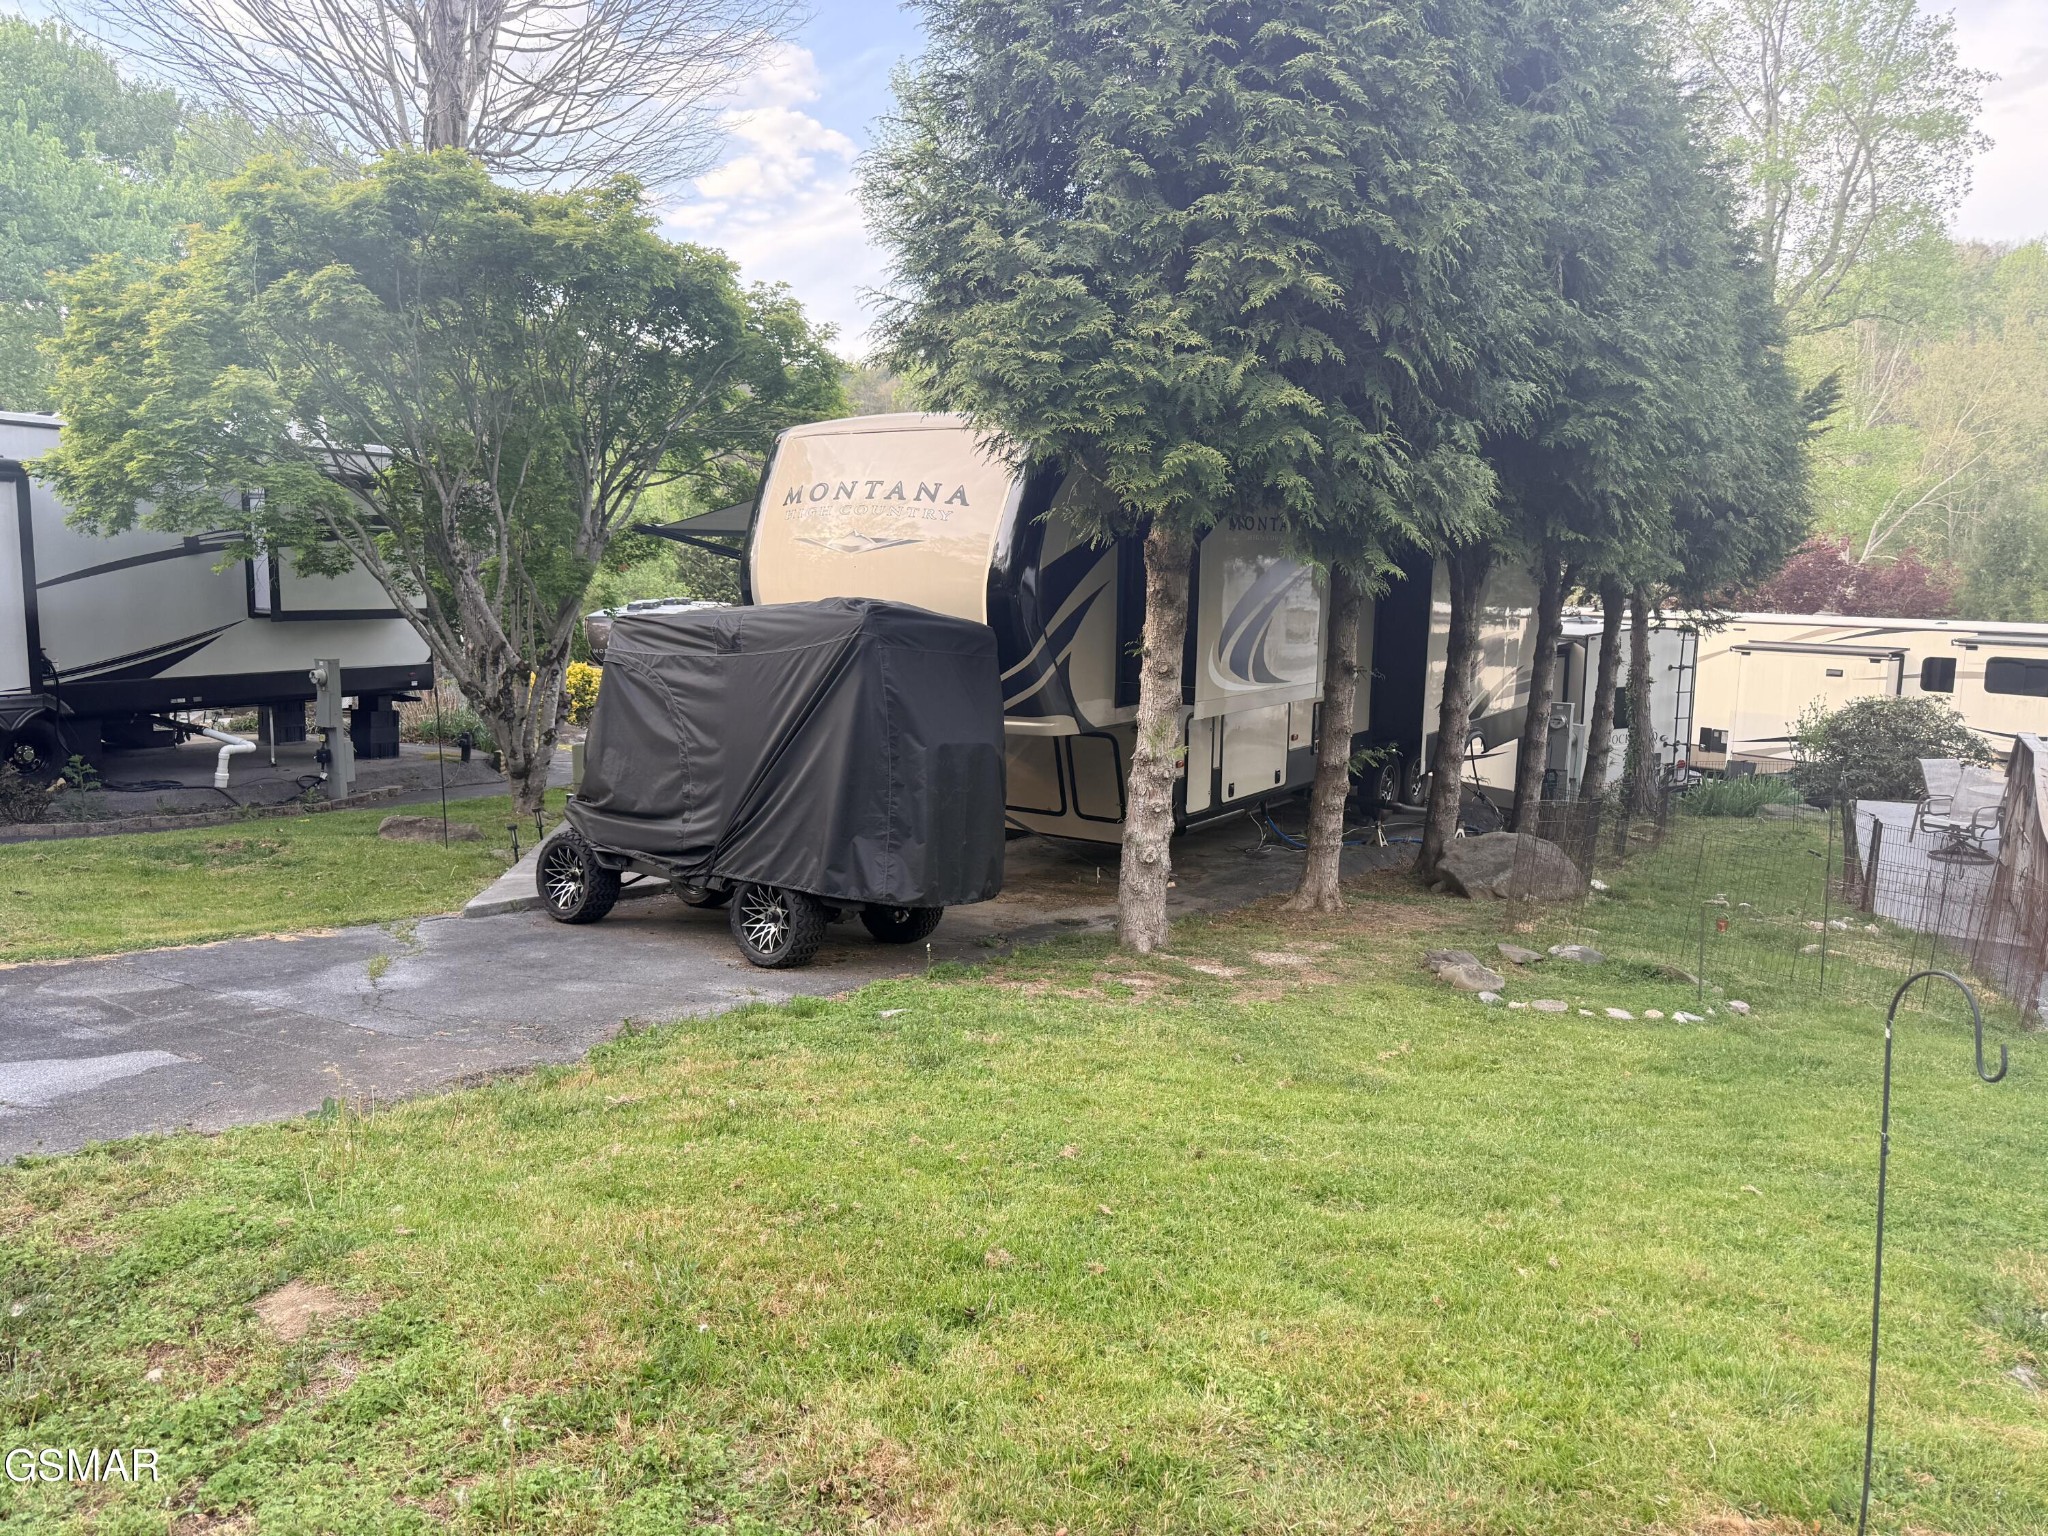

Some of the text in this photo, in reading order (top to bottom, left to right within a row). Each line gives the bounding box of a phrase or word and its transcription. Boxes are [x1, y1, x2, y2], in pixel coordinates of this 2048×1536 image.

[783, 481, 969, 506] MONTANA
[785, 505, 953, 521] HIGH COUNTRY
[1229, 516, 1287, 531] MONTA
